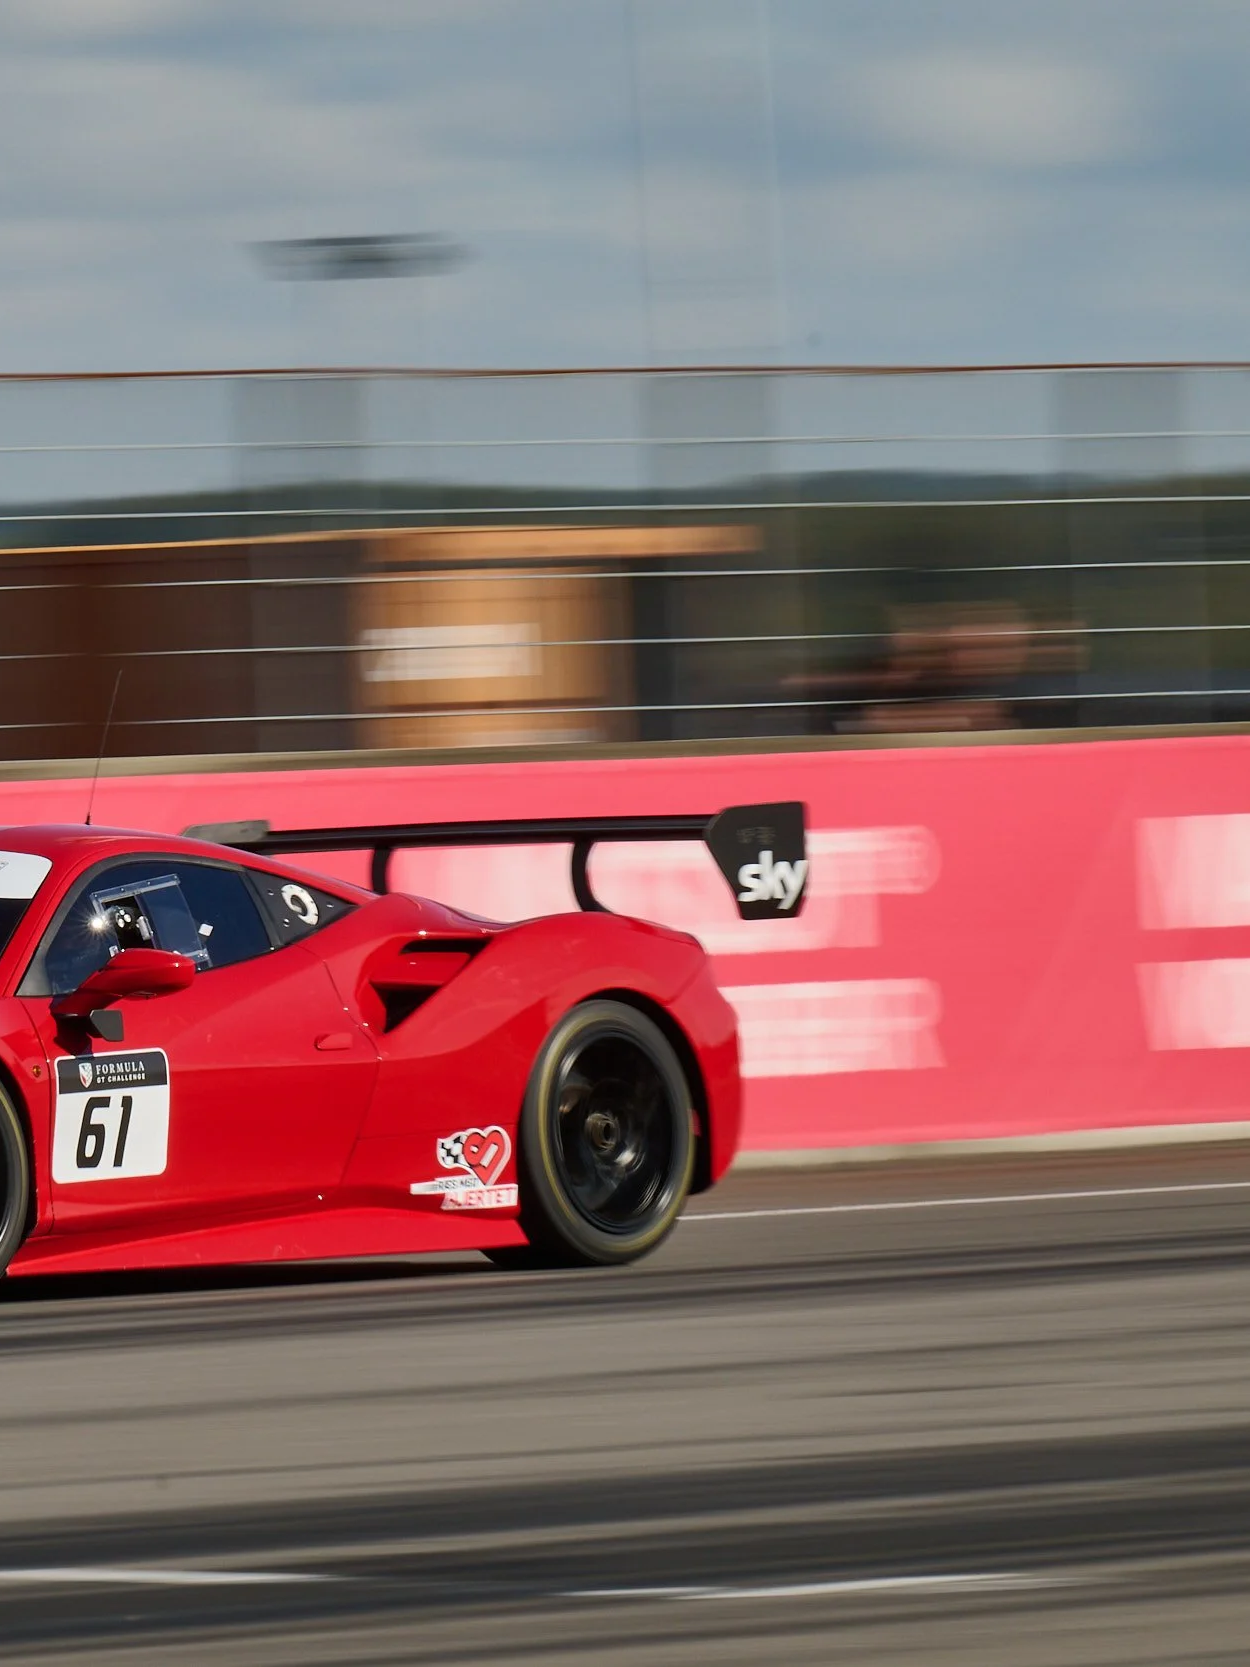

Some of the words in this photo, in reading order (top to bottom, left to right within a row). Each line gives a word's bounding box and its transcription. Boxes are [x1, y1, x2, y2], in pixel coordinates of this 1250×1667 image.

[737, 849, 809, 910] sky
[96, 1060, 145, 1075] FORMULA
[96, 1076, 105, 1084] GT
[107, 1073, 146, 1083] CHALLENGE
[76, 1095, 133, 1169] 61
